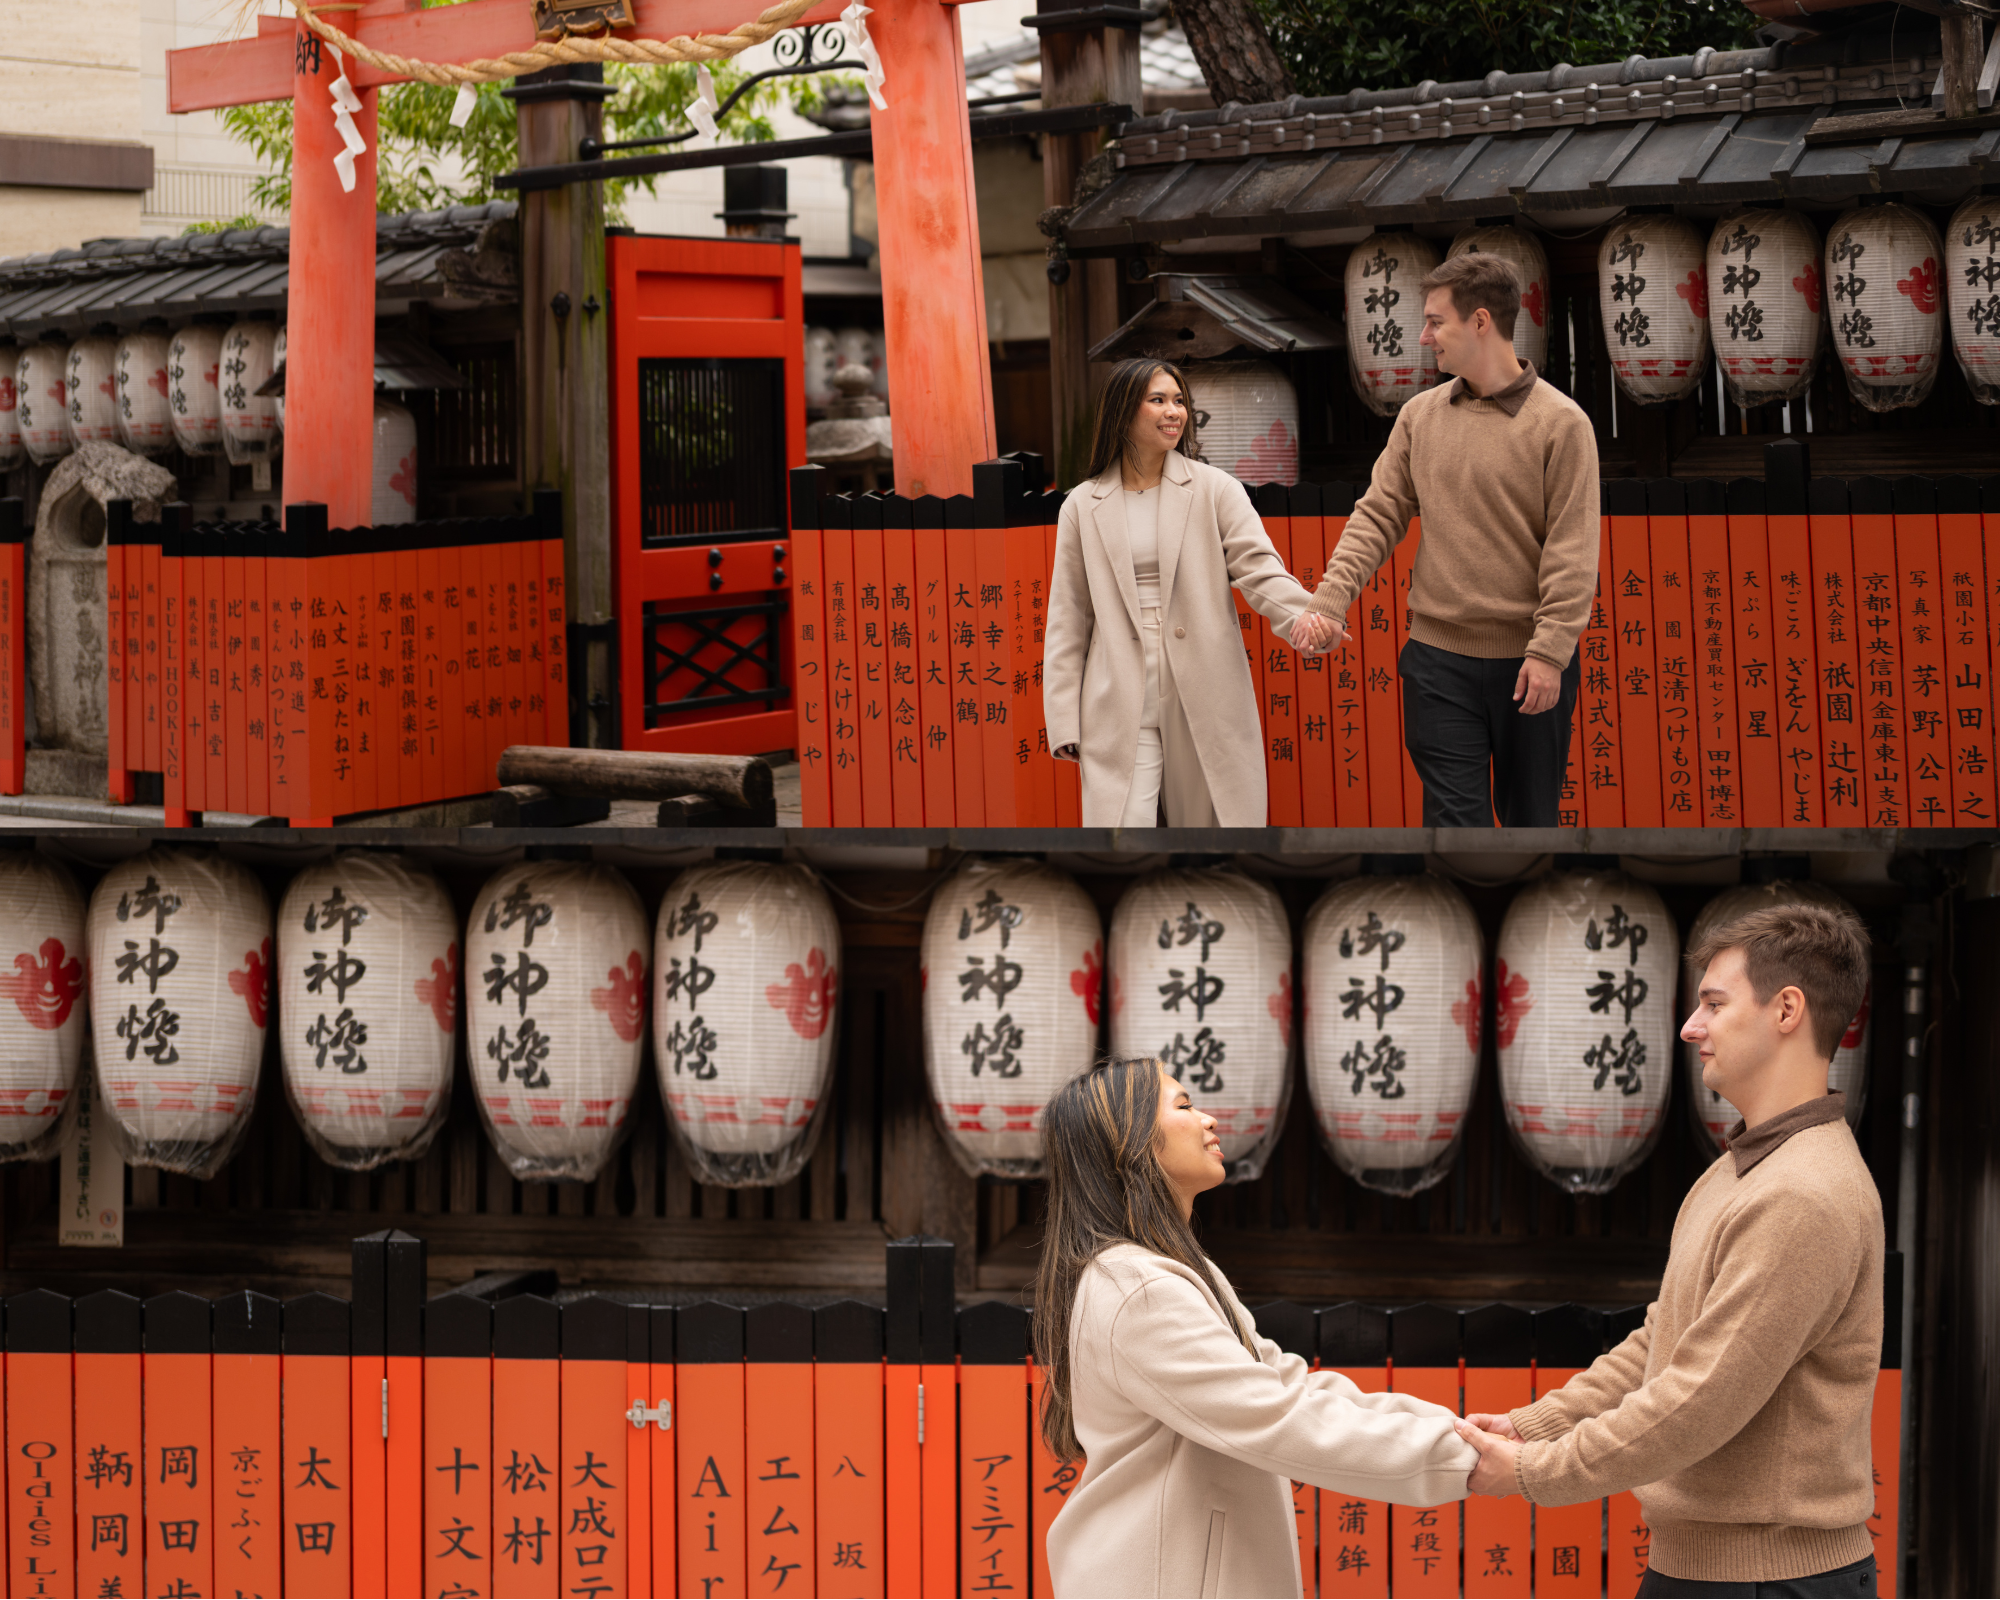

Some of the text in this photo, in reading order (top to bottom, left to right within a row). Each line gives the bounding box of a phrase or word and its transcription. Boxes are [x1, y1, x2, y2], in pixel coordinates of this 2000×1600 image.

[165, 598, 179, 778] FULL HOOKING
[1619, 568, 1651, 697] 金竹堂
[115, 875, 182, 1066] 御神燈
[302, 886, 370, 1075] 御神燈
[482, 882, 553, 1090] 御神燈
[665, 891, 719, 1081] 御神燈
[958, 889, 1025, 1079] 御神燈
[1338, 911, 1405, 1100] 御神燈
[1583, 904, 1649, 1096] 御神燈
[21, 1441, 58, 1599] Oldies Li
[294, 1446, 342, 1556] 太田
[501, 1449, 554, 1566] 松村
[1410, 1509, 1444, 1576] 石段下
